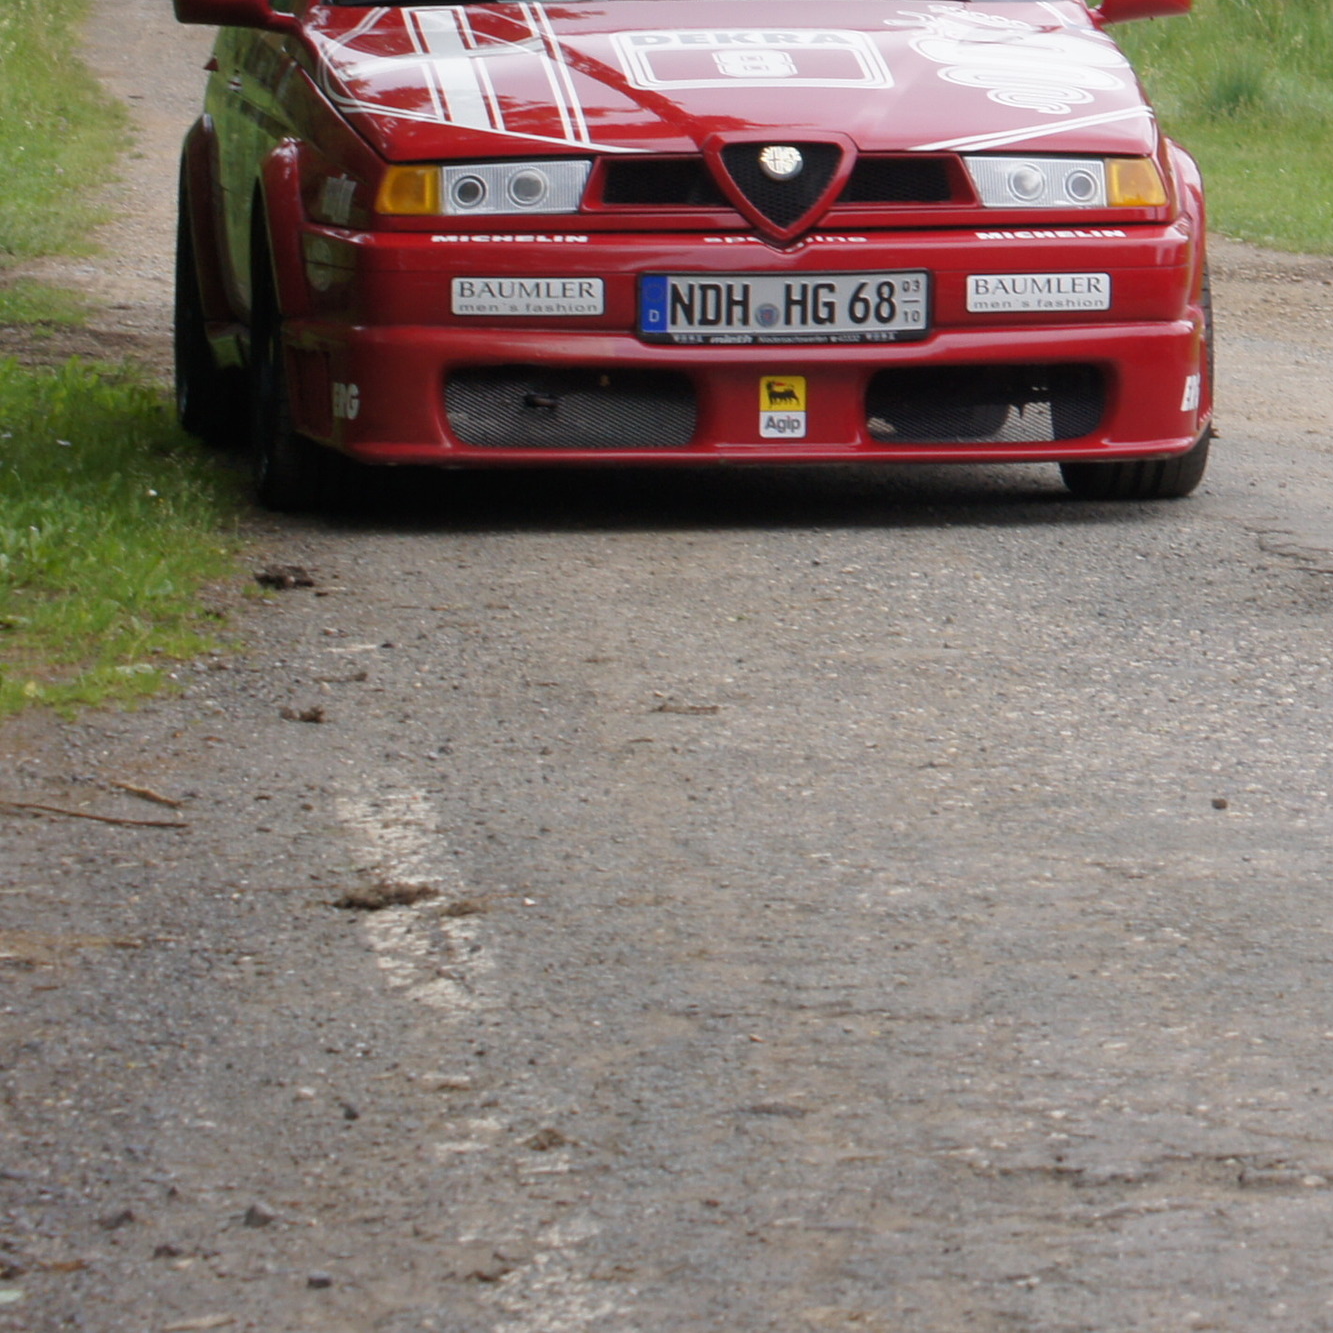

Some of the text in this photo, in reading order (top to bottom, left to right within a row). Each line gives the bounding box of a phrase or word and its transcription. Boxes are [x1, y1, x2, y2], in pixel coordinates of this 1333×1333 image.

[630, 32, 852, 46] DEKRA
[430, 234, 589, 243] MICHELIN
[974, 229, 1128, 240] MICHELIN
[525, 302, 598, 314] fashion
[669, 280, 897, 326] NDH HG 68
[1036, 297, 1105, 309] fashion
[648, 309, 660, 323] D
[764, 415, 801, 433] Agip
